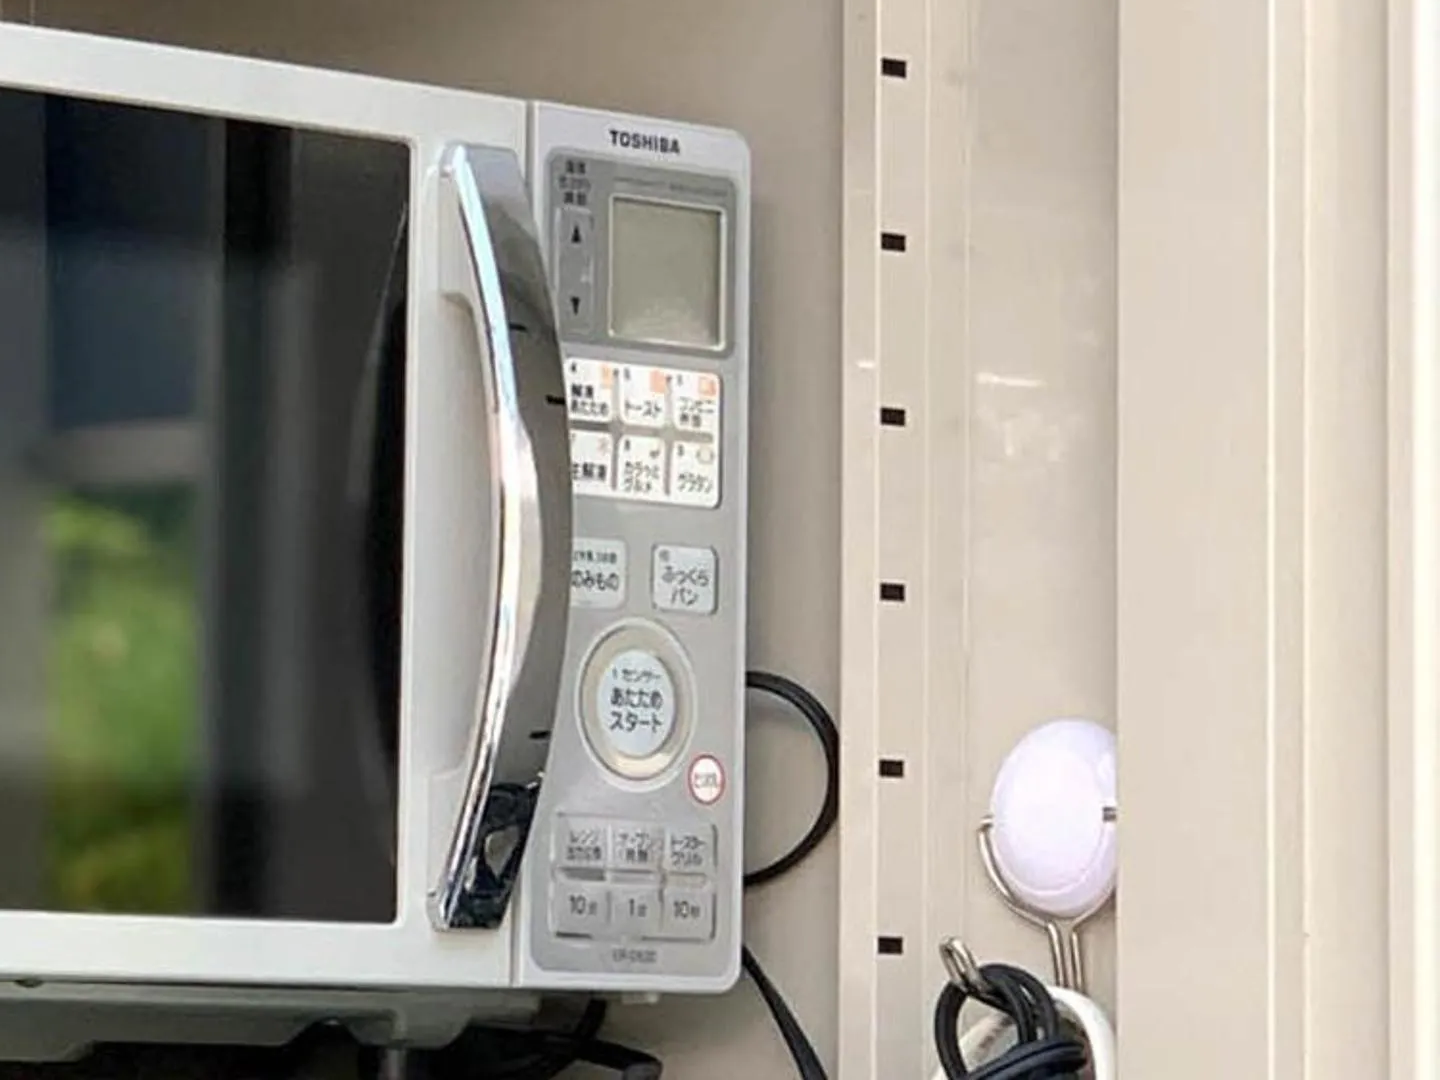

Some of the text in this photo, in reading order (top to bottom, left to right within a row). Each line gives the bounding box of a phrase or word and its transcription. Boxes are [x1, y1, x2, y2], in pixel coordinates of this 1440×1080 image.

[609, 130, 680, 154] TOSHIBA
[624, 400, 662, 418] トースト
[571, 570, 620, 592] のみもの
[661, 566, 710, 587] ふっくら
[670, 587, 699, 606] パン
[610, 687, 664, 709] あたため
[610, 710, 664, 733] スタート
